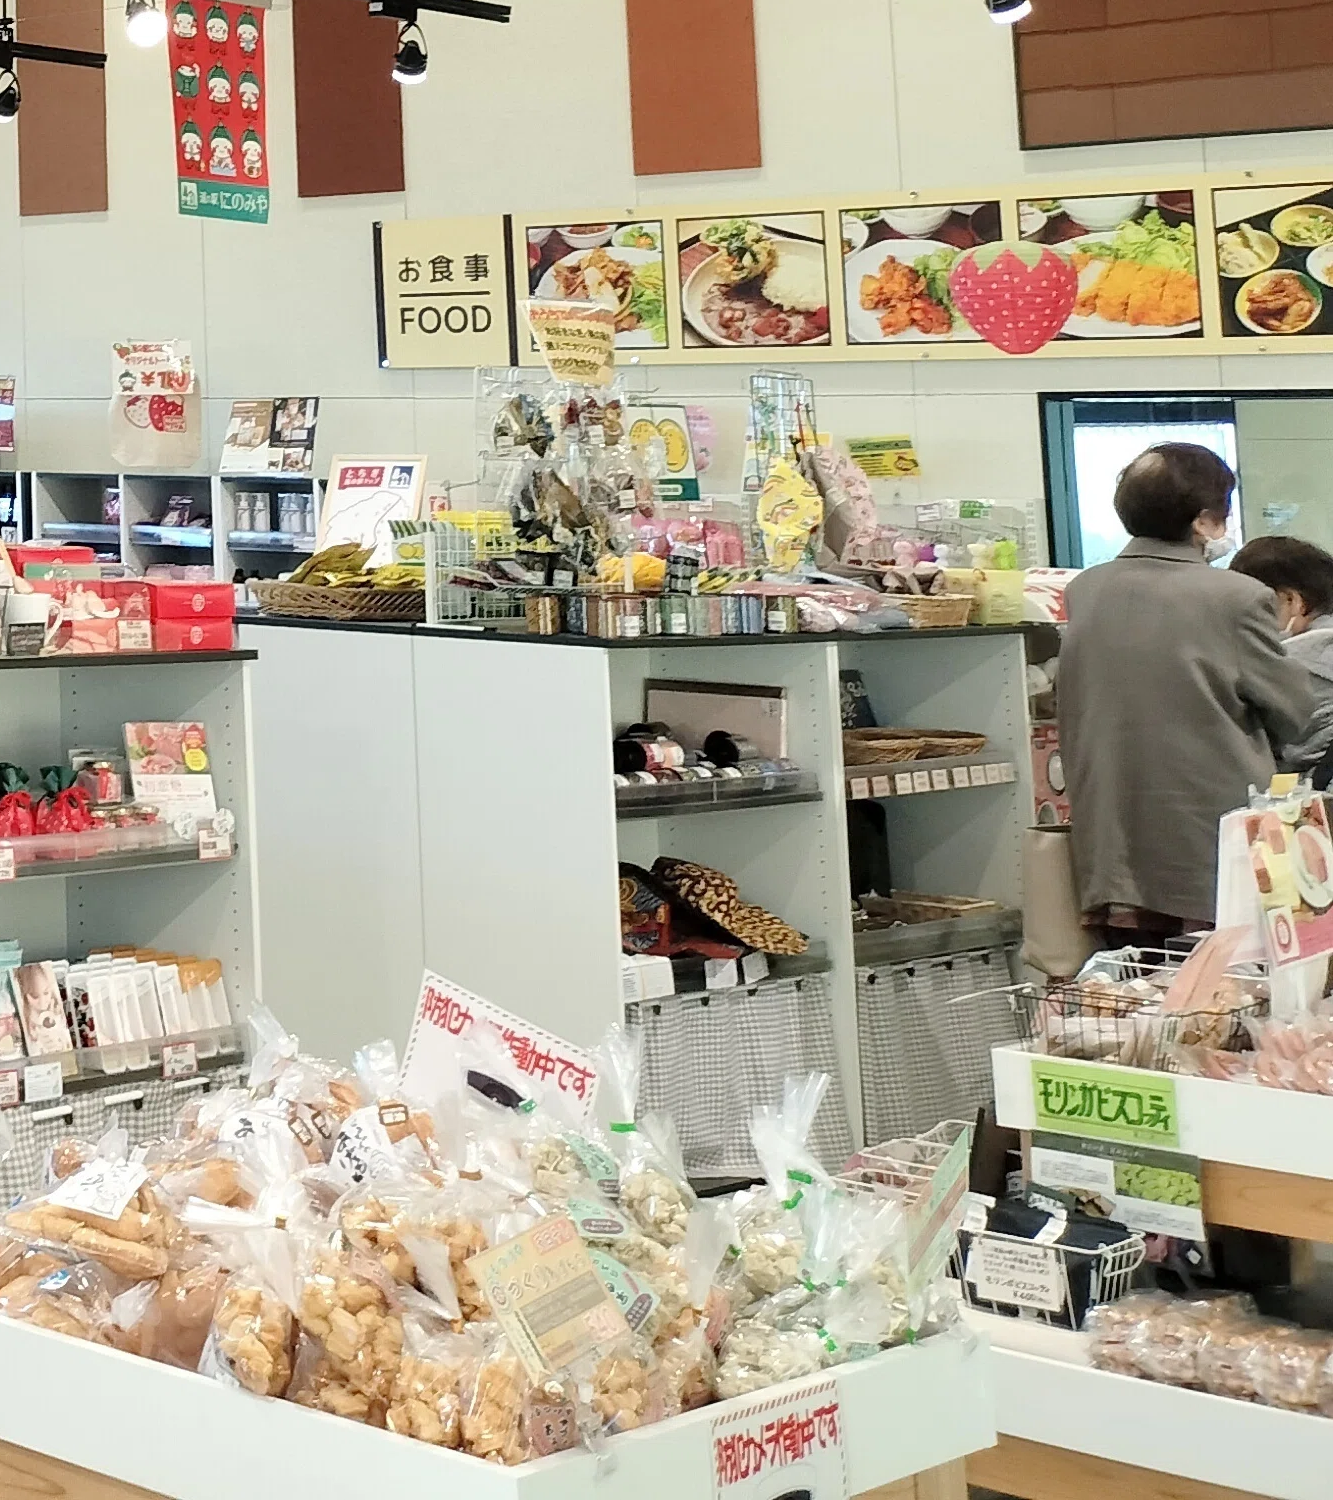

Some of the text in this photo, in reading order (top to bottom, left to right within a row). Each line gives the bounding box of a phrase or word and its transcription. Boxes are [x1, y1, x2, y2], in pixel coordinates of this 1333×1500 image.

[220, 191, 268, 214] にのみや
[398, 253, 490, 283] お食事
[399, 305, 492, 335] FOOD
[715, 1401, 839, 1488] 防犯カメラ作動中です
